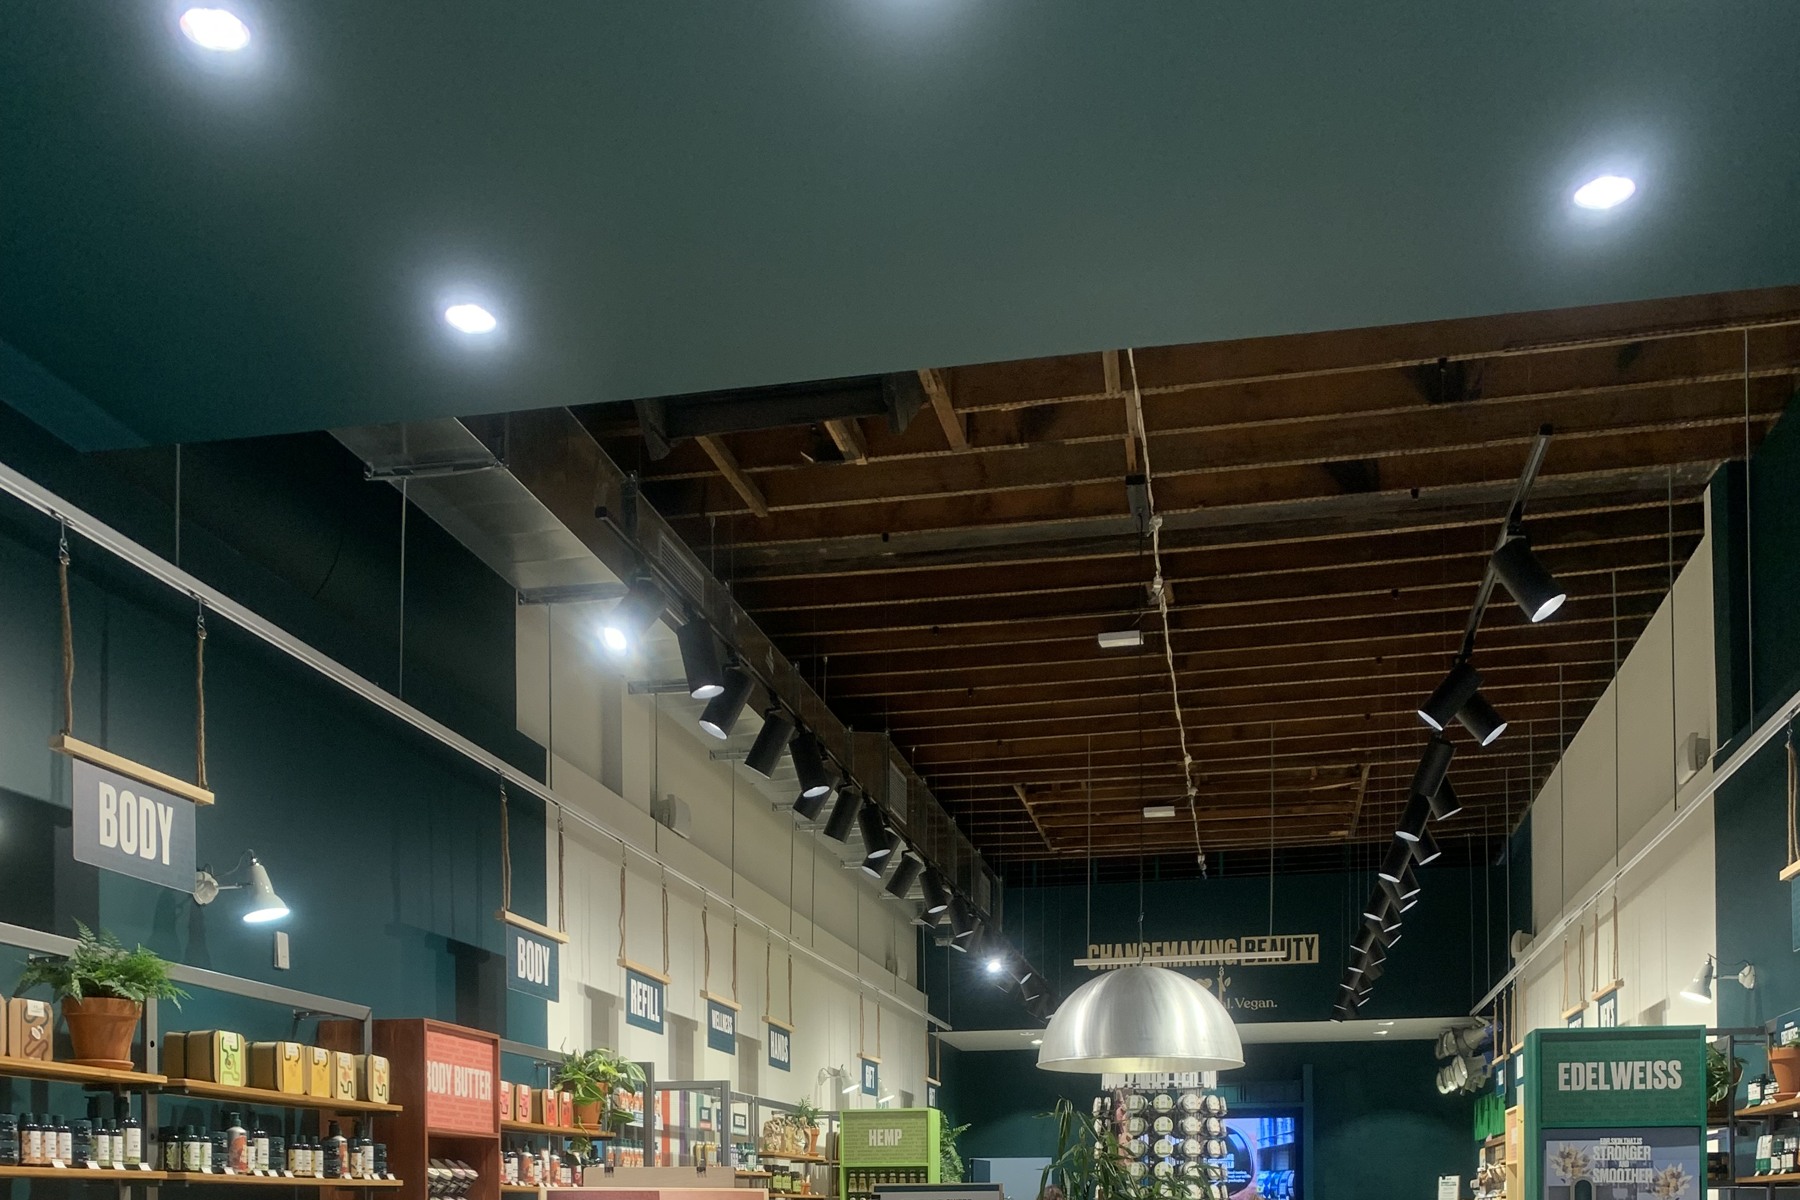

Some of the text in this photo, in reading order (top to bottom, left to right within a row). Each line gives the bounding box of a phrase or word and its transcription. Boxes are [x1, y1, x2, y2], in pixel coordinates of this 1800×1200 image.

[99, 781, 173, 865] BODY
[517, 936, 550, 986] BODY
[1088, 937, 1316, 970] CHANGEMAKING BEAUTY
[630, 978, 661, 1023] REFILL
[1234, 997, 1278, 1010] Vegan.
[711, 1009, 733, 1035] WELLNESS
[770, 1030, 788, 1063] HANDS
[427, 1060, 491, 1100] BODY BUTTER
[1558, 1060, 1682, 1091] EDELWEISS
[868, 1128, 902, 1146] HEMP
[1593, 1145, 1651, 1160] STRONGER
[1592, 1168, 1653, 1183] SMOOTHER
